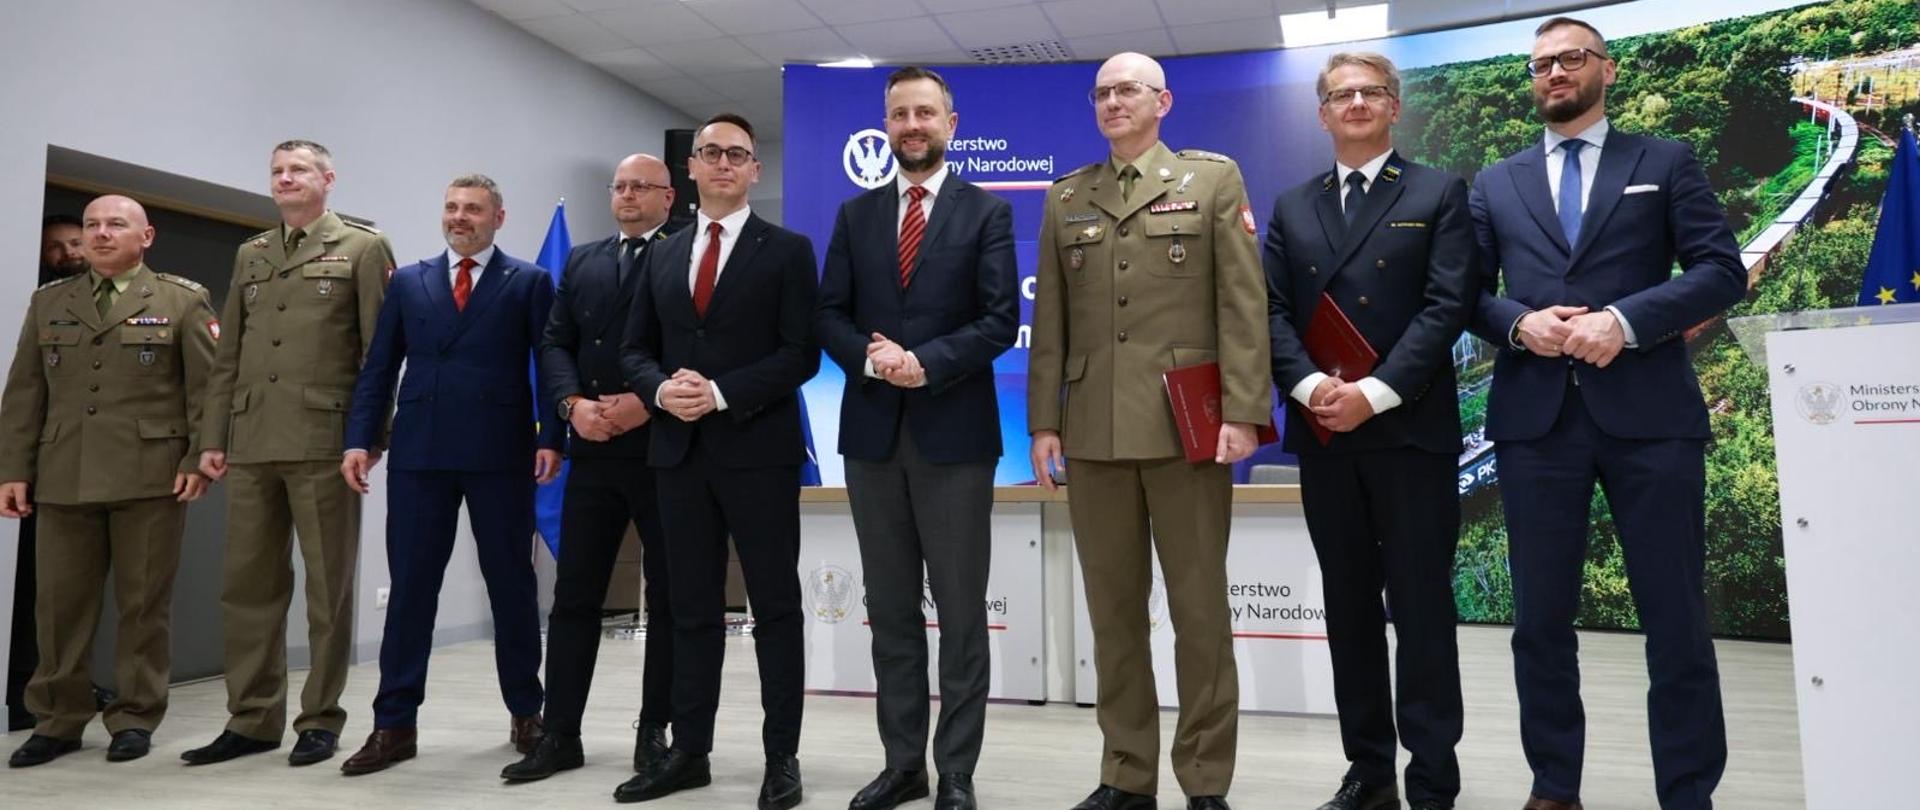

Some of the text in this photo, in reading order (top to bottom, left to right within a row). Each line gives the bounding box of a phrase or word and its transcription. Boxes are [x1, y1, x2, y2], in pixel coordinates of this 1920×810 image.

[946, 136, 1008, 152] terstwo
[967, 155, 1054, 175] Narodowej
[1850, 384, 1920, 395] Ministers
[1852, 400, 1908, 412] Obrony
[1477, 459, 1496, 481] PK
[1229, 582, 1292, 598] erstwo
[1246, 603, 1327, 621] Narodow
